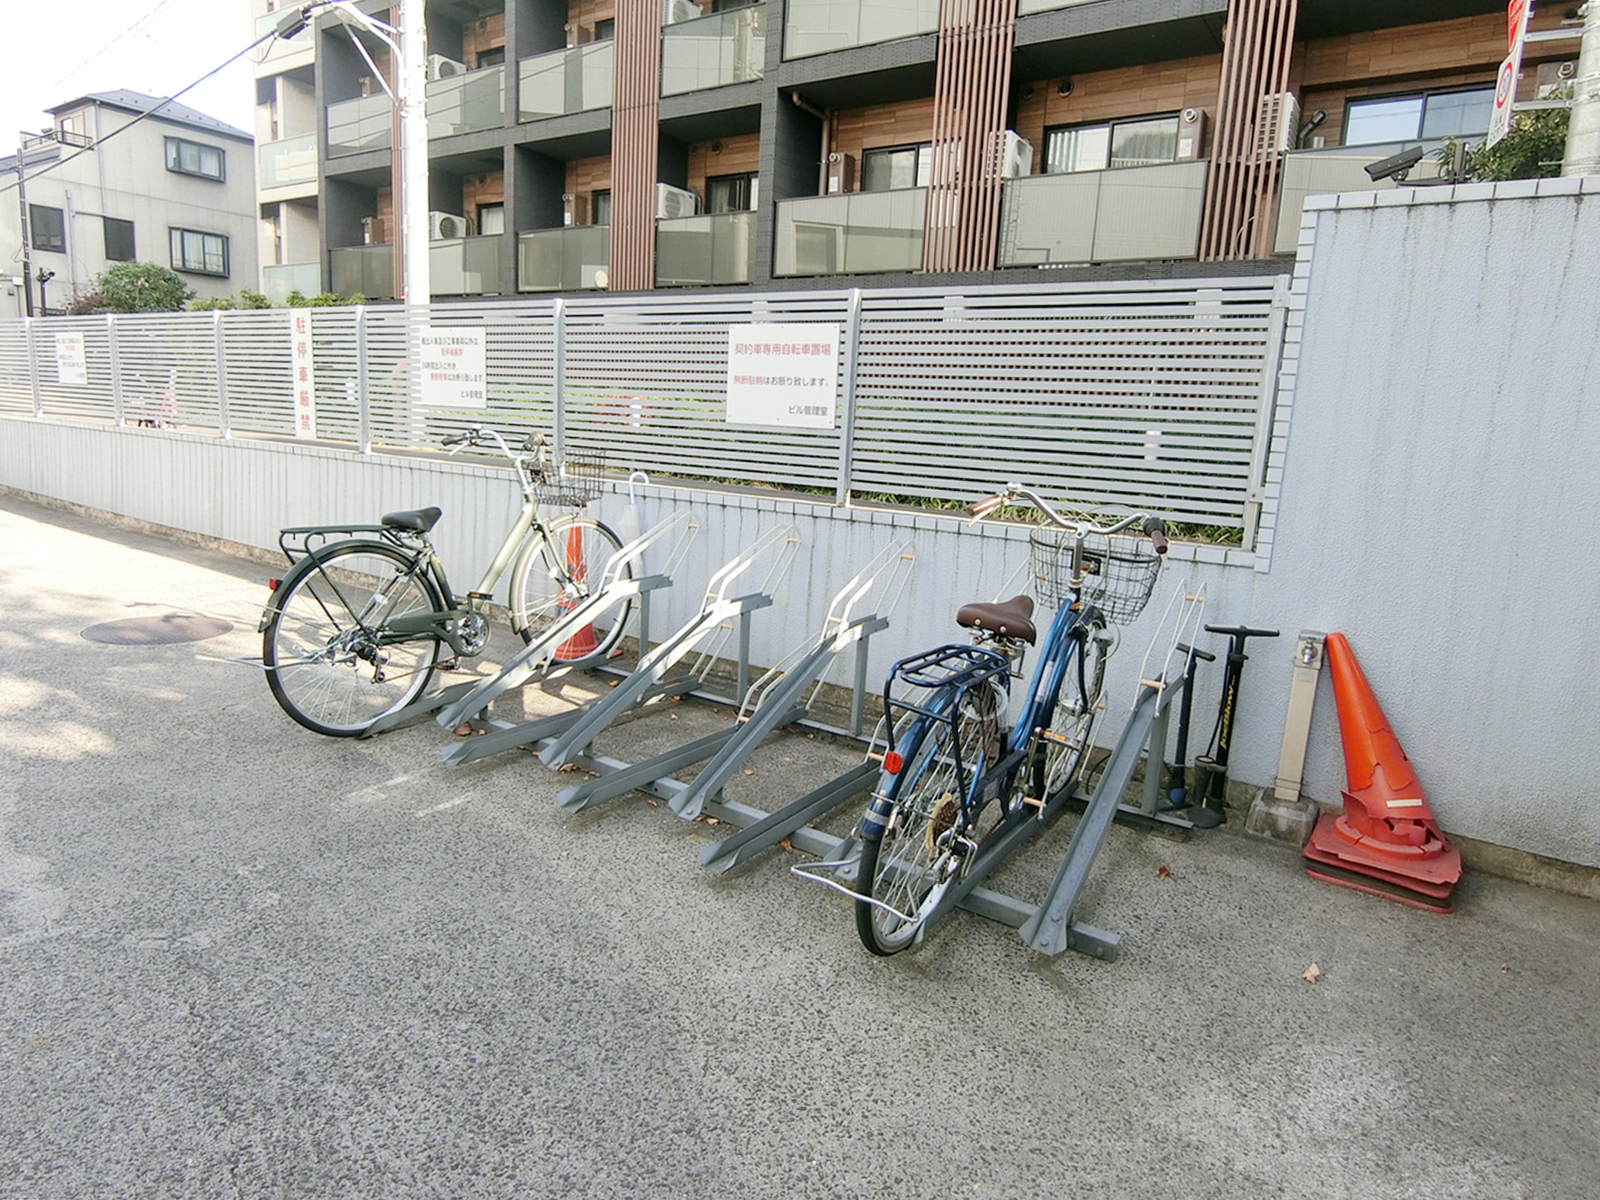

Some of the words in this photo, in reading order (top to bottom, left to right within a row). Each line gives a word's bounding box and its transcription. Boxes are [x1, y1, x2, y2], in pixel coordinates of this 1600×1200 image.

[734, 343, 832, 356] 契約車専用自転車置場
[296, 316, 311, 431] 駐停車厳禁
[788, 405, 829, 416] ビル管理室
